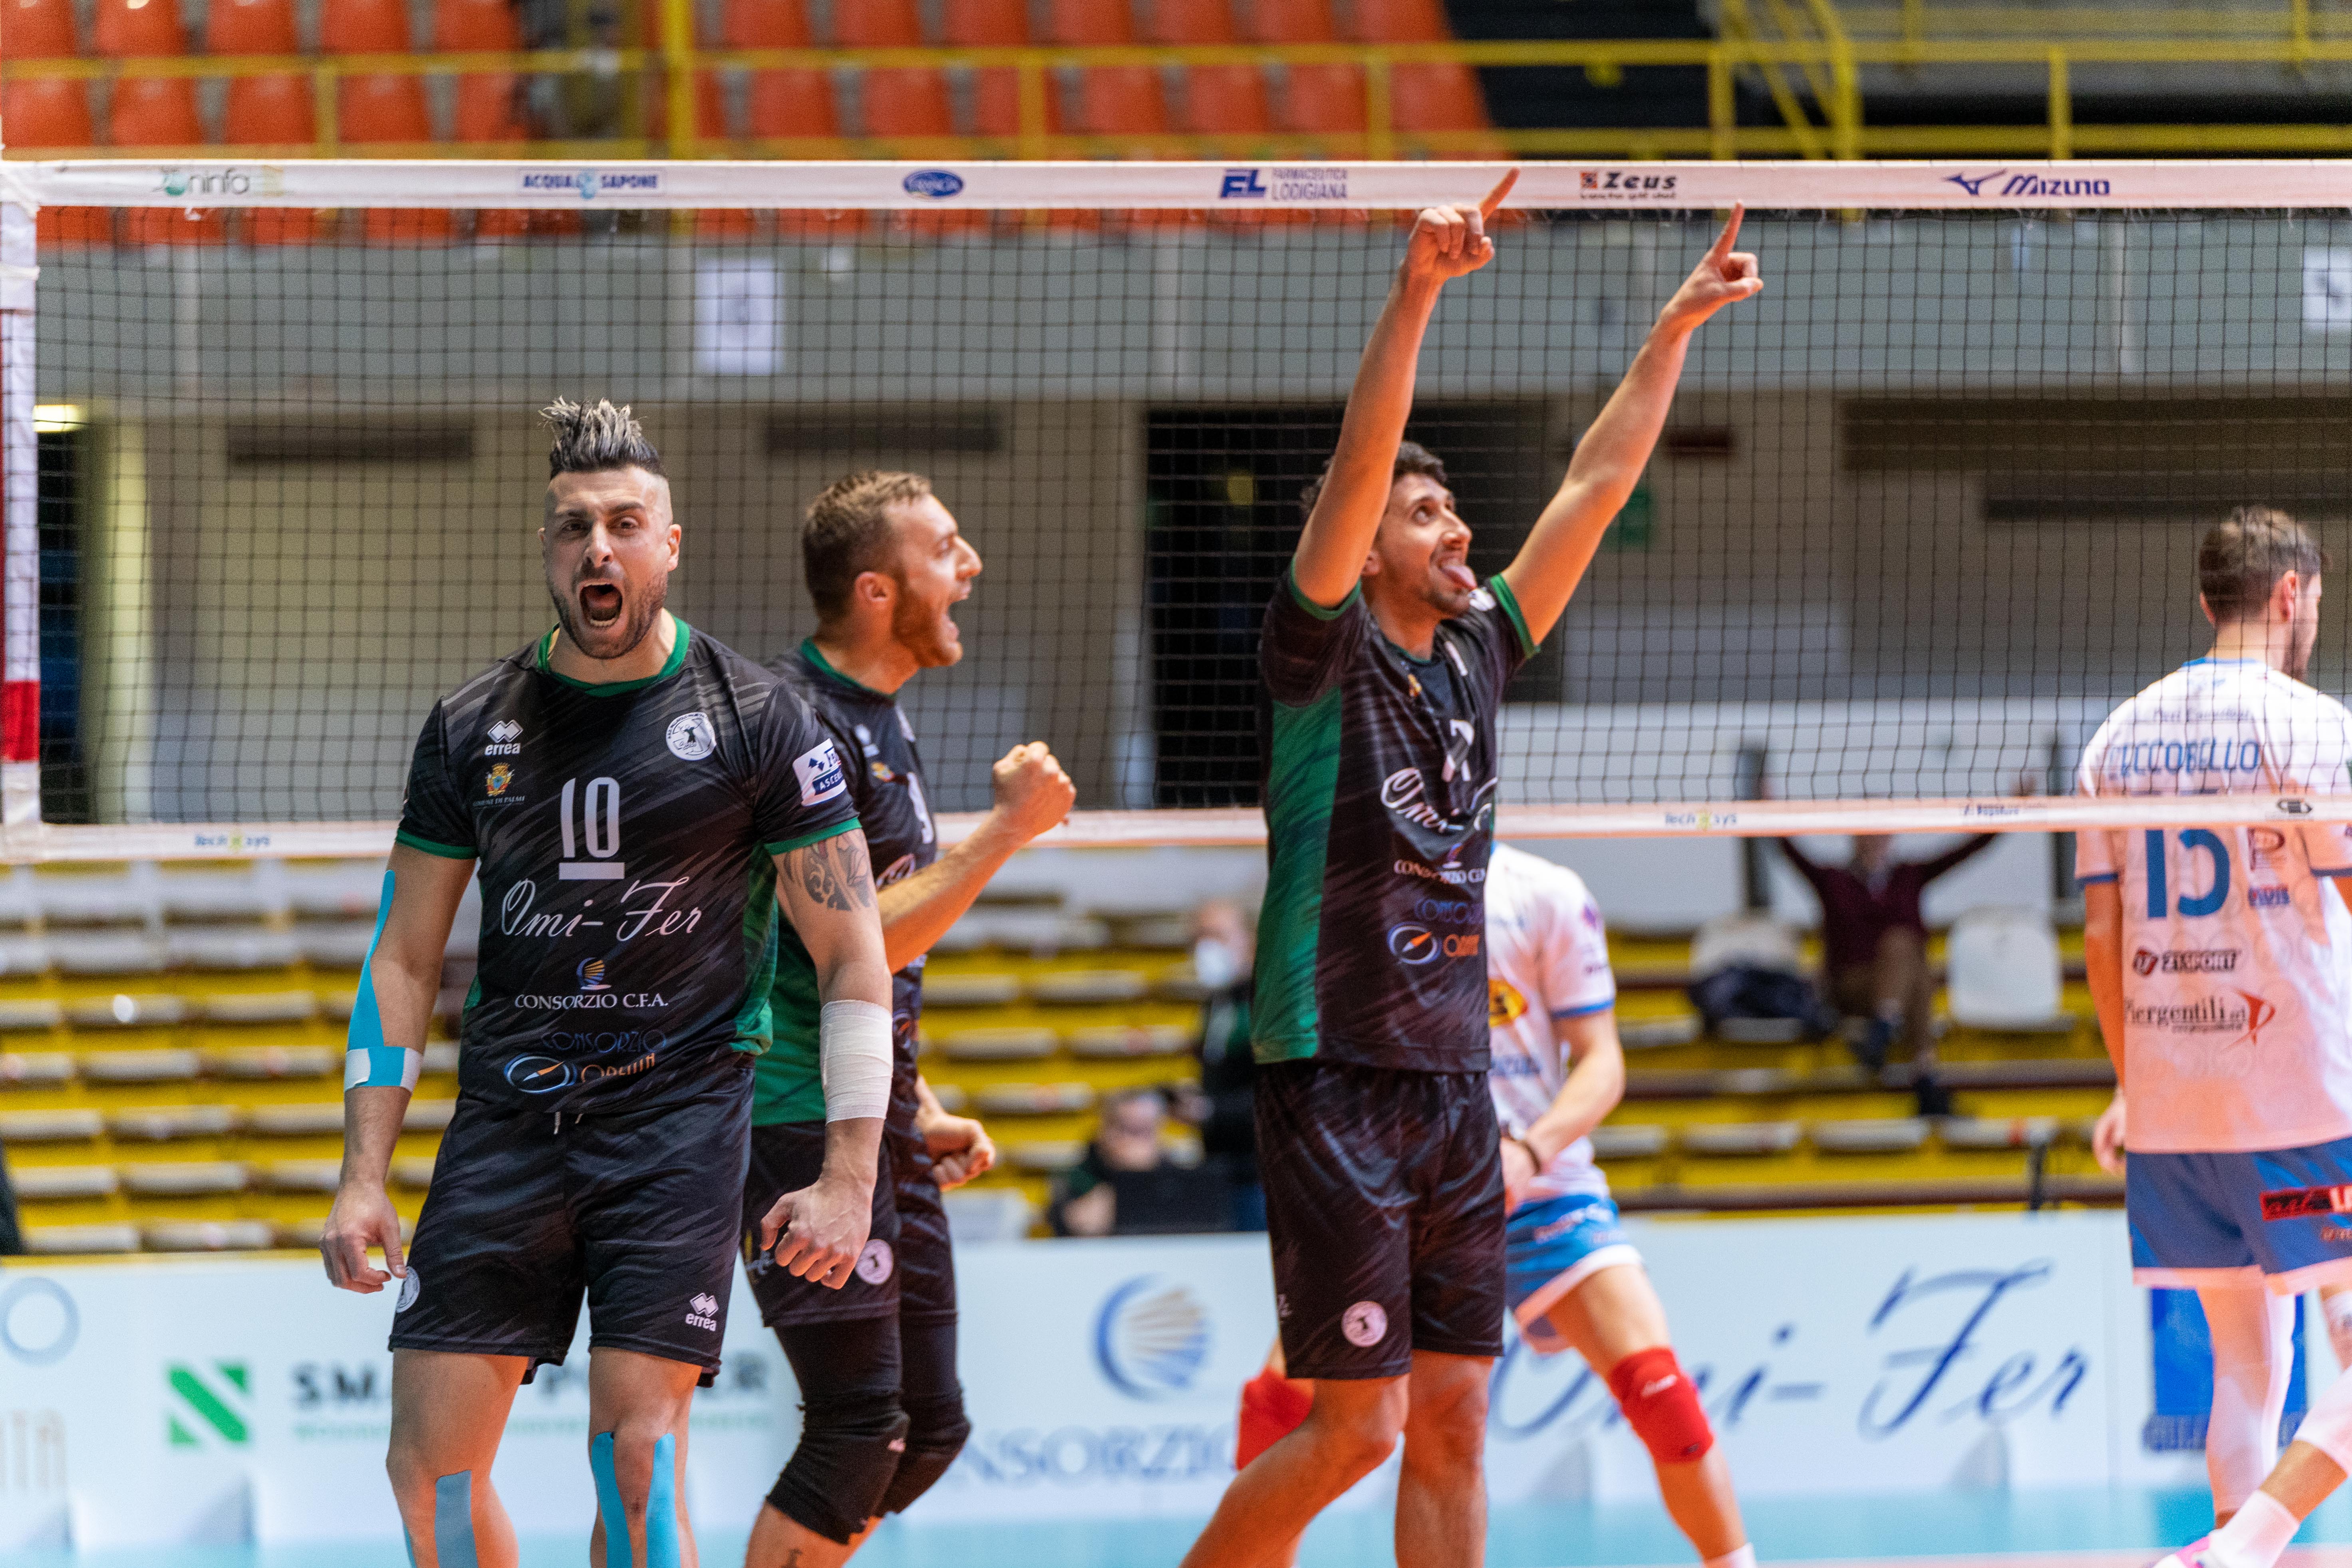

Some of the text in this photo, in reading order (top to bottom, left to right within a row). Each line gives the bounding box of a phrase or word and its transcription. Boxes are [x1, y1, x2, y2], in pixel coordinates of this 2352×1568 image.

[1603, 171, 1676, 189] Zeus
[560, 777, 620, 858] 10
[515, 994, 668, 1010] CONSORZIO C.F.A.
